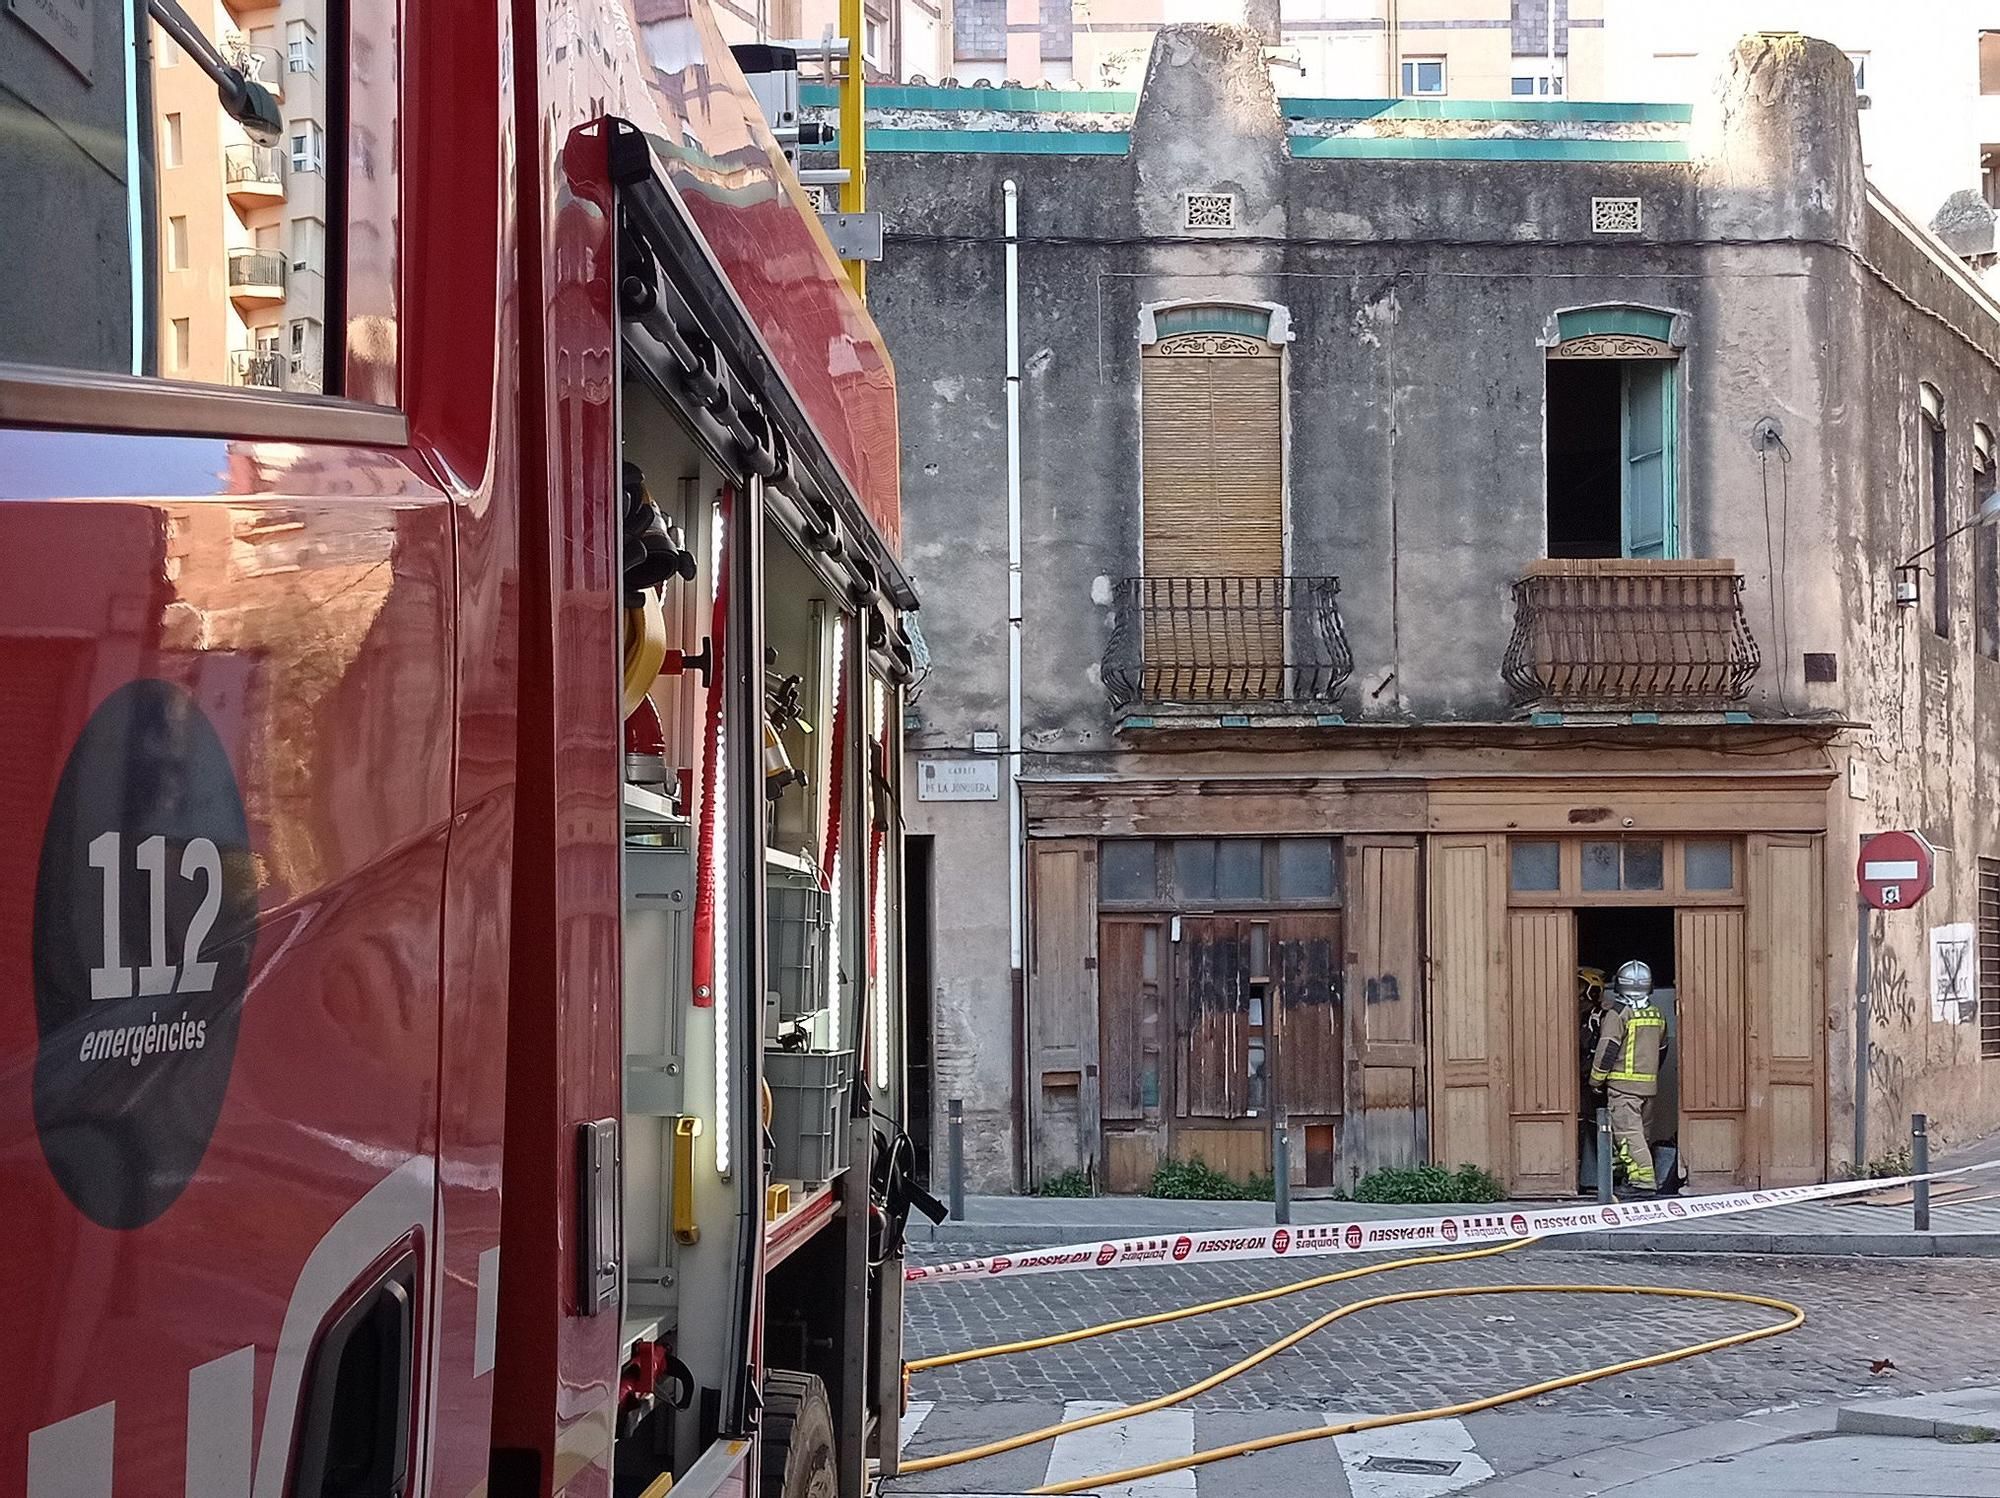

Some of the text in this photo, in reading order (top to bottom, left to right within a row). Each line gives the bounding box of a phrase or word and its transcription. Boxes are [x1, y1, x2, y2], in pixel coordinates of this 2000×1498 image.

[937, 783, 949, 793] LA
[88, 831, 223, 1001] 112
[1690, 1199, 1732, 1214] PASSEU
[1732, 1197, 1751, 1208] NO
[1533, 1214, 1597, 1230] NO PASSEU
[1368, 1226, 1435, 1243] NO PASSEU
[1463, 1226, 1508, 1239] bombers
[1174, 1245, 1188, 1256] 112
[1196, 1237, 1267, 1253] NO PASSEU
[1295, 1238, 1340, 1250] bombers
[1016, 1253, 1070, 1269] PASSEU
[1069, 1252, 1092, 1264] NO
[1118, 1250, 1167, 1262] bombers
